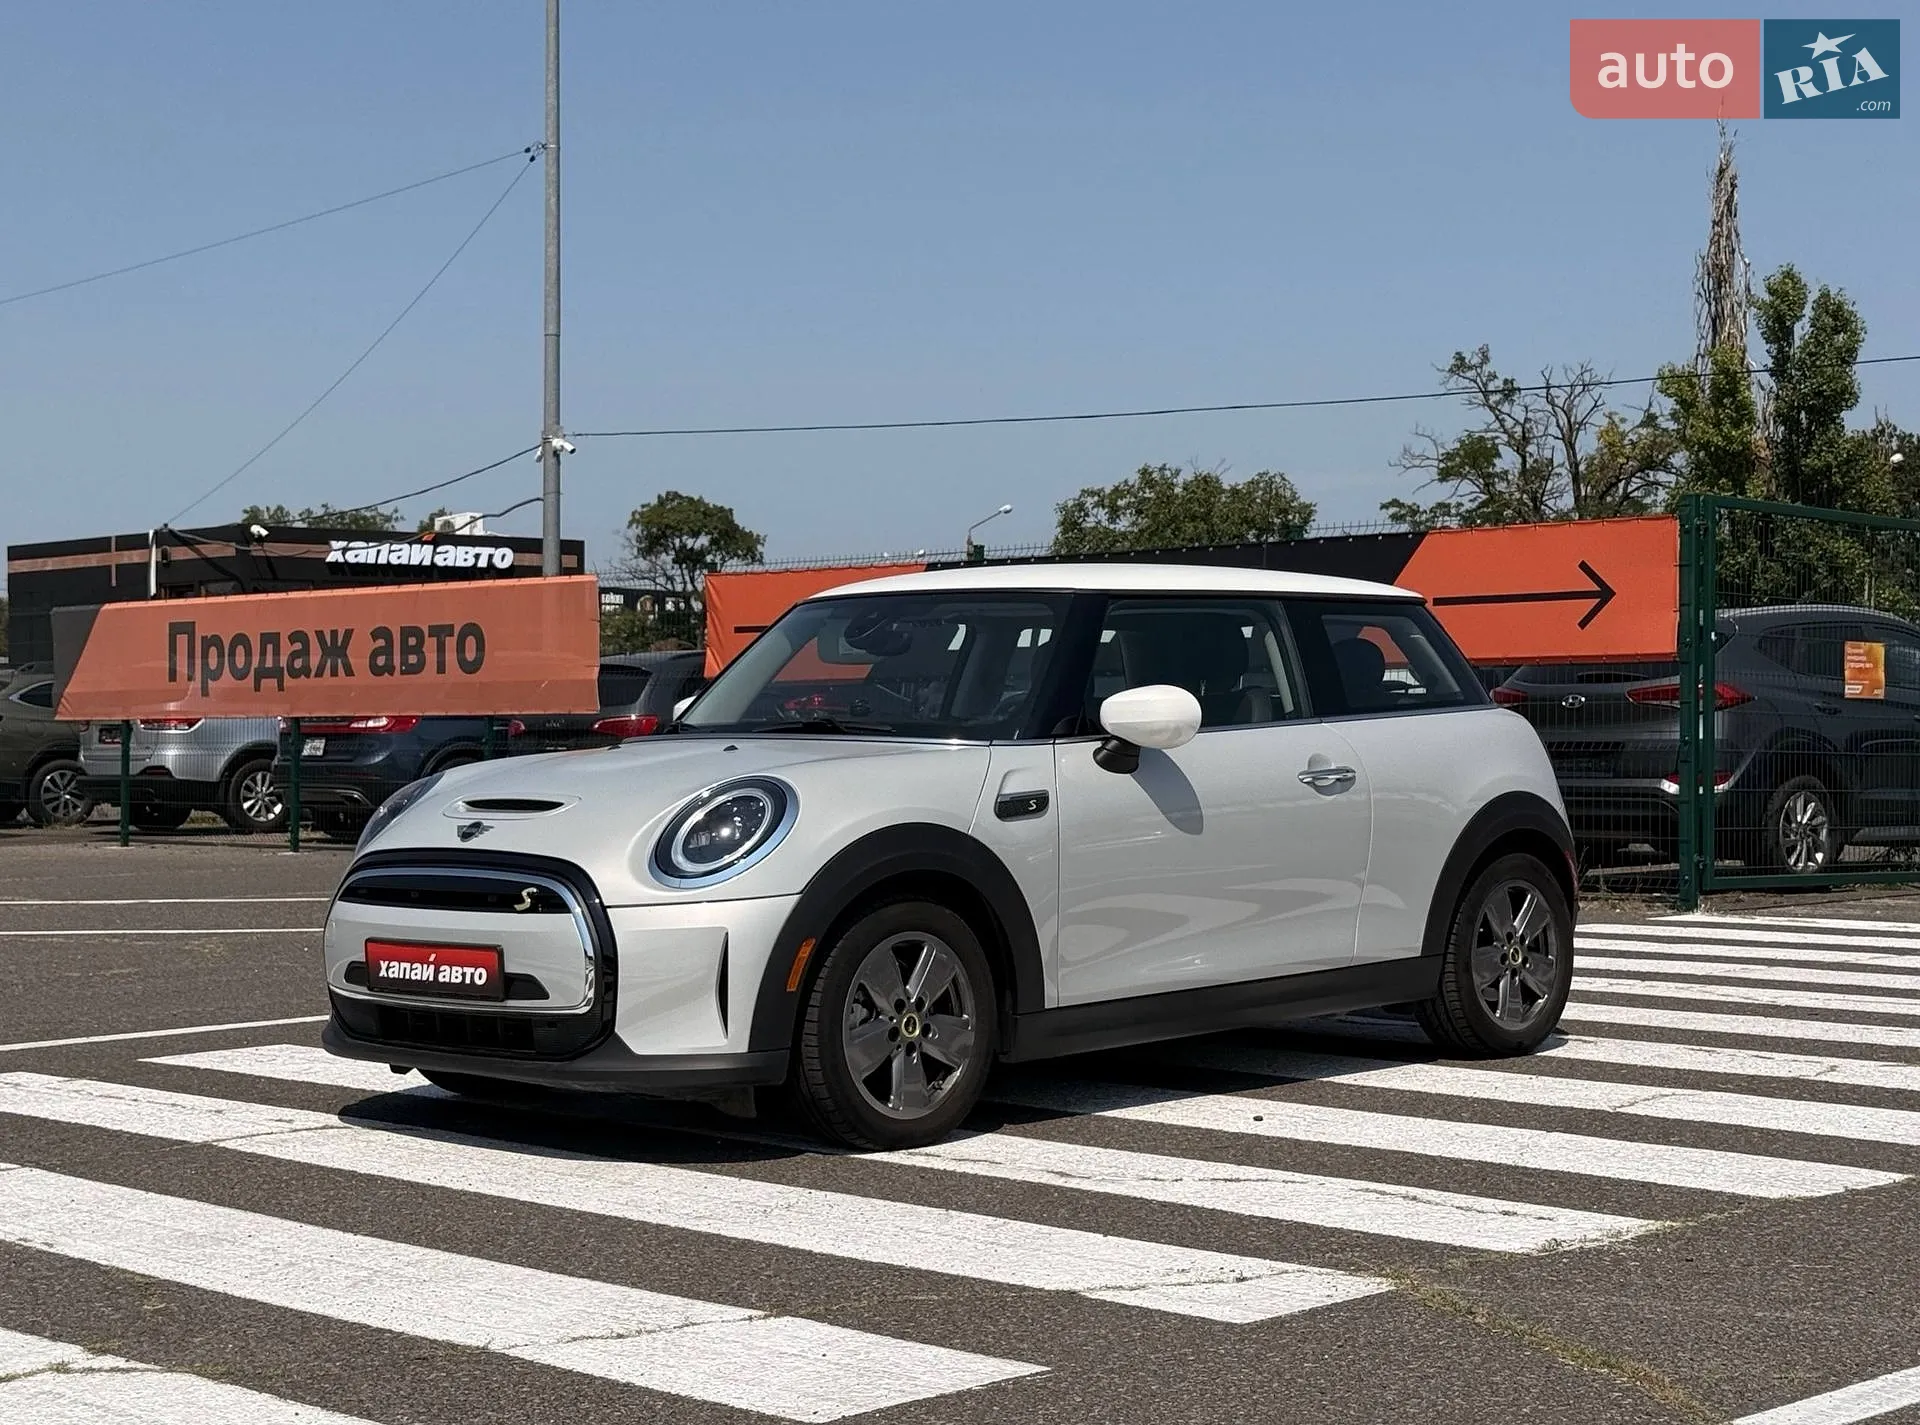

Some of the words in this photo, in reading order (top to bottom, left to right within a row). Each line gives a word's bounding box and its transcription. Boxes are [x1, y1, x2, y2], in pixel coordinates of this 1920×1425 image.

[167, 620, 356, 698] Продаж
[367, 621, 486, 677] авто
[379, 953, 437, 982] хапай
[438, 964, 488, 986] авто
